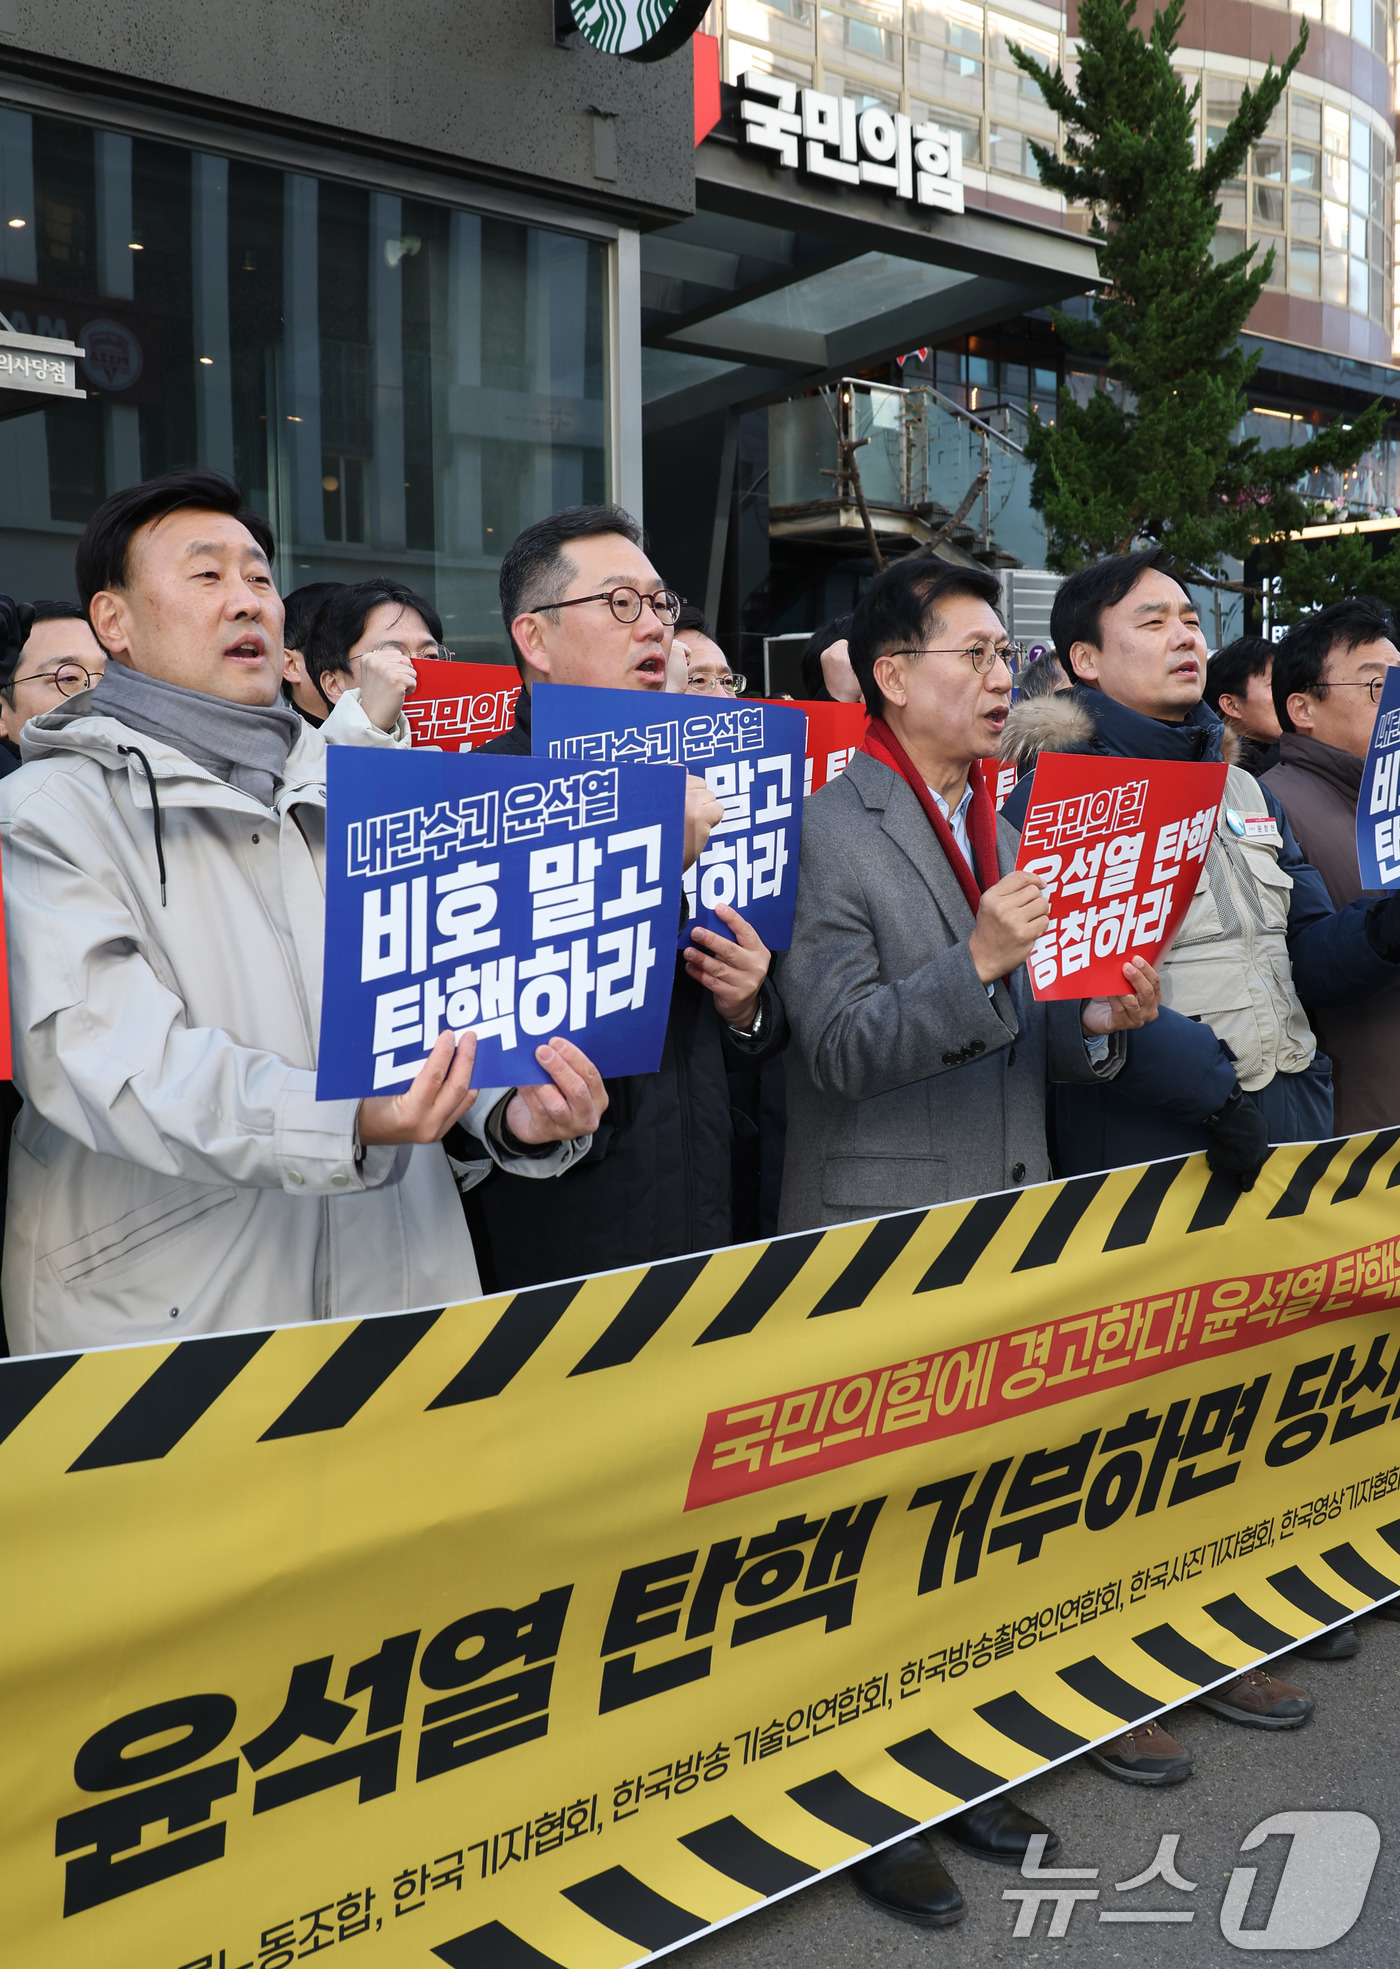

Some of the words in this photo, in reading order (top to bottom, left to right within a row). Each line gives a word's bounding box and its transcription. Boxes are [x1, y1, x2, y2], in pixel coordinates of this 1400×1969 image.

[738, 71, 965, 214] 국민의힘
[683, 707, 764, 762] 윤석열
[347, 790, 499, 877] 내란수괴
[503, 767, 619, 844] 윤석열
[1024, 779, 1149, 850] 국민의힘
[1150, 805, 1218, 885] 탄핵
[361, 859, 501, 983] 비호
[529, 824, 663, 941] 말고
[372, 920, 657, 1090] 탄핵하라
[711, 1340, 1001, 1473] 국민의힘에
[1000, 1289, 1200, 1401] 경고한다!
[1199, 1263, 1329, 1345] 윤석열
[55, 1582, 575, 1920] 윤석열
[599, 1495, 888, 1716] 탄핵
[906, 1373, 1273, 1597] 거부하면
[1264, 1332, 1400, 1468] 당신
[392, 1793, 603, 1918] 한국기자협회,
[899, 1578, 1125, 1700] 한국방송촬영인연합회,
[1129, 1516, 1276, 1604] 한국사진기자협회,
